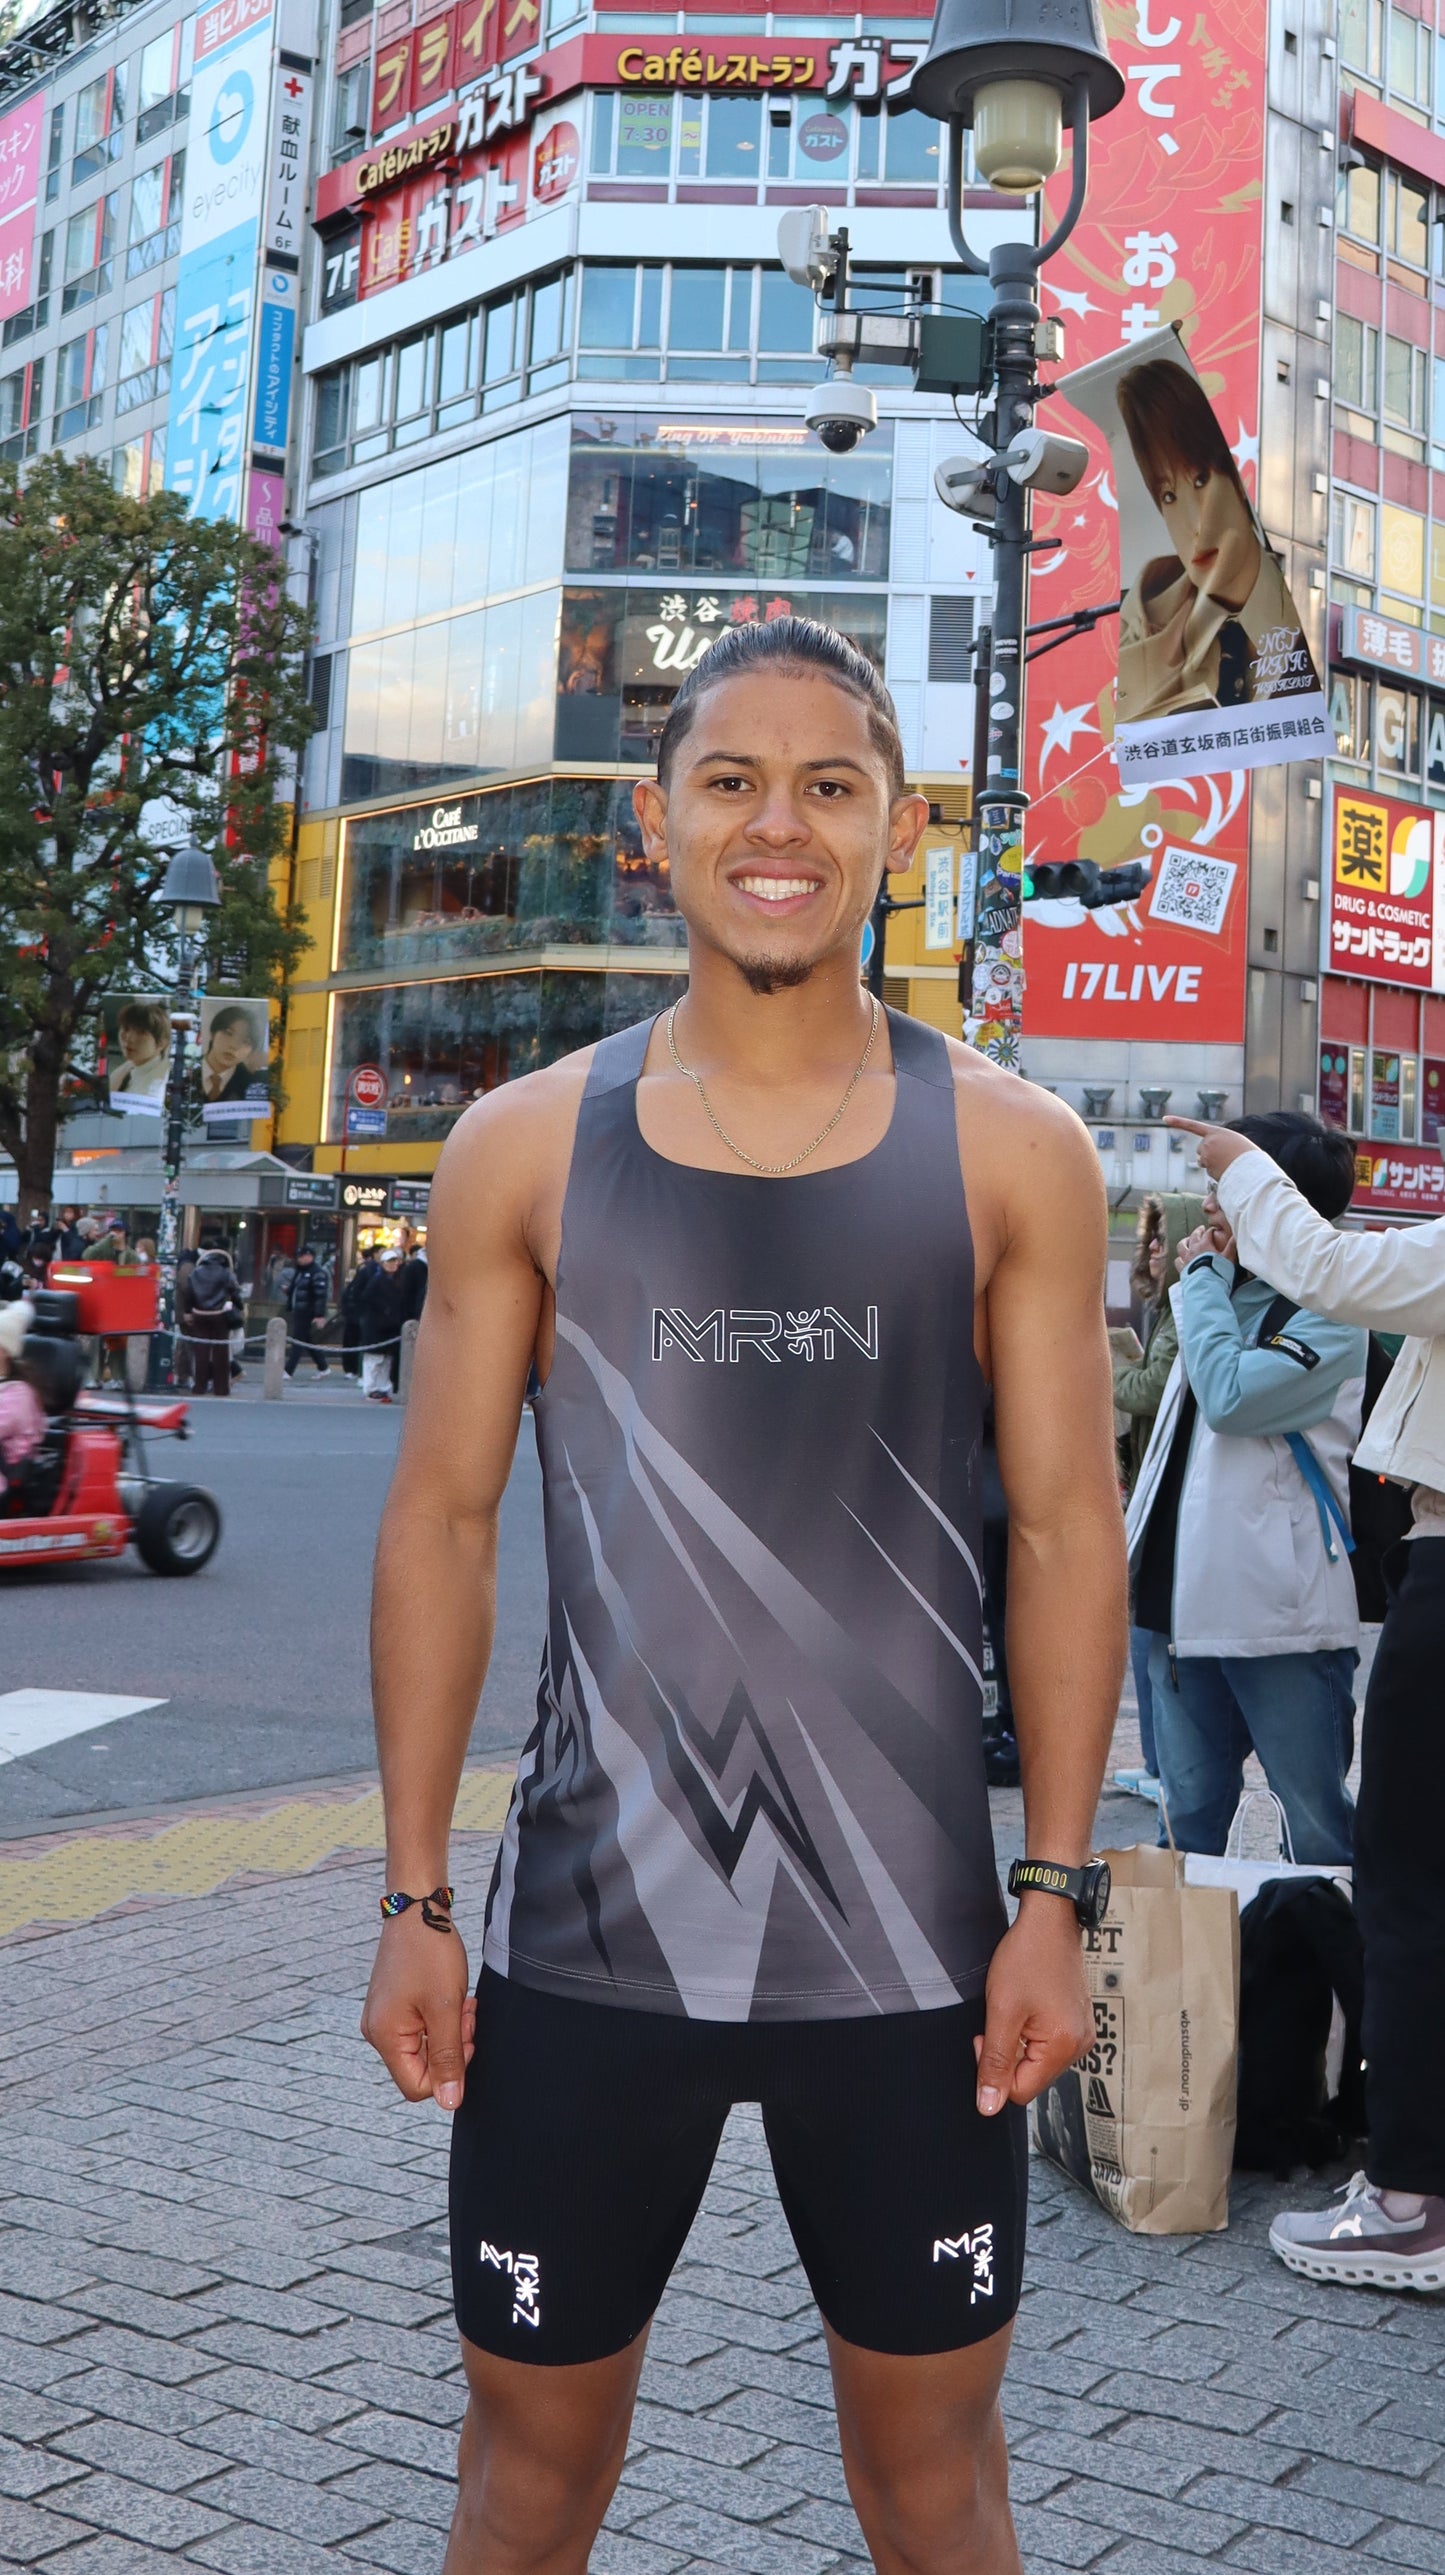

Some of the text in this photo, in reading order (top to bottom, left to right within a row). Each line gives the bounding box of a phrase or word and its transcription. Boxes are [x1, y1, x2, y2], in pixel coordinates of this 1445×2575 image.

[826, 38, 930, 98] ガス
[455, 65, 542, 157] ガスト
[623, 102, 670, 117] OPEN
[623, 126, 668, 142] 7:30
[804, 133, 842, 148] ガスト
[192, 160, 261, 222] eyecity
[274, 114, 301, 230] 献血ルーム
[537, 155, 576, 187] ガスト
[274, 235, 293, 250] 6F
[411, 168, 518, 275] ガスト
[326, 246, 360, 299] 7F
[1363, 618, 1413, 667] 薄毛
[1124, 716, 1326, 763] 渋谷道玄坂商店街振興組合
[1342, 808, 1383, 883] 薬
[1334, 893, 1431, 929] DRUG & COSMETIC
[1332, 919, 1432, 968] サンドラッグ
[1062, 962, 1203, 1003] 17LIVE
[1389, 1161, 1445, 1193] サンドラ
[1179, 2009, 1193, 2112] wbstudiotour.jp
